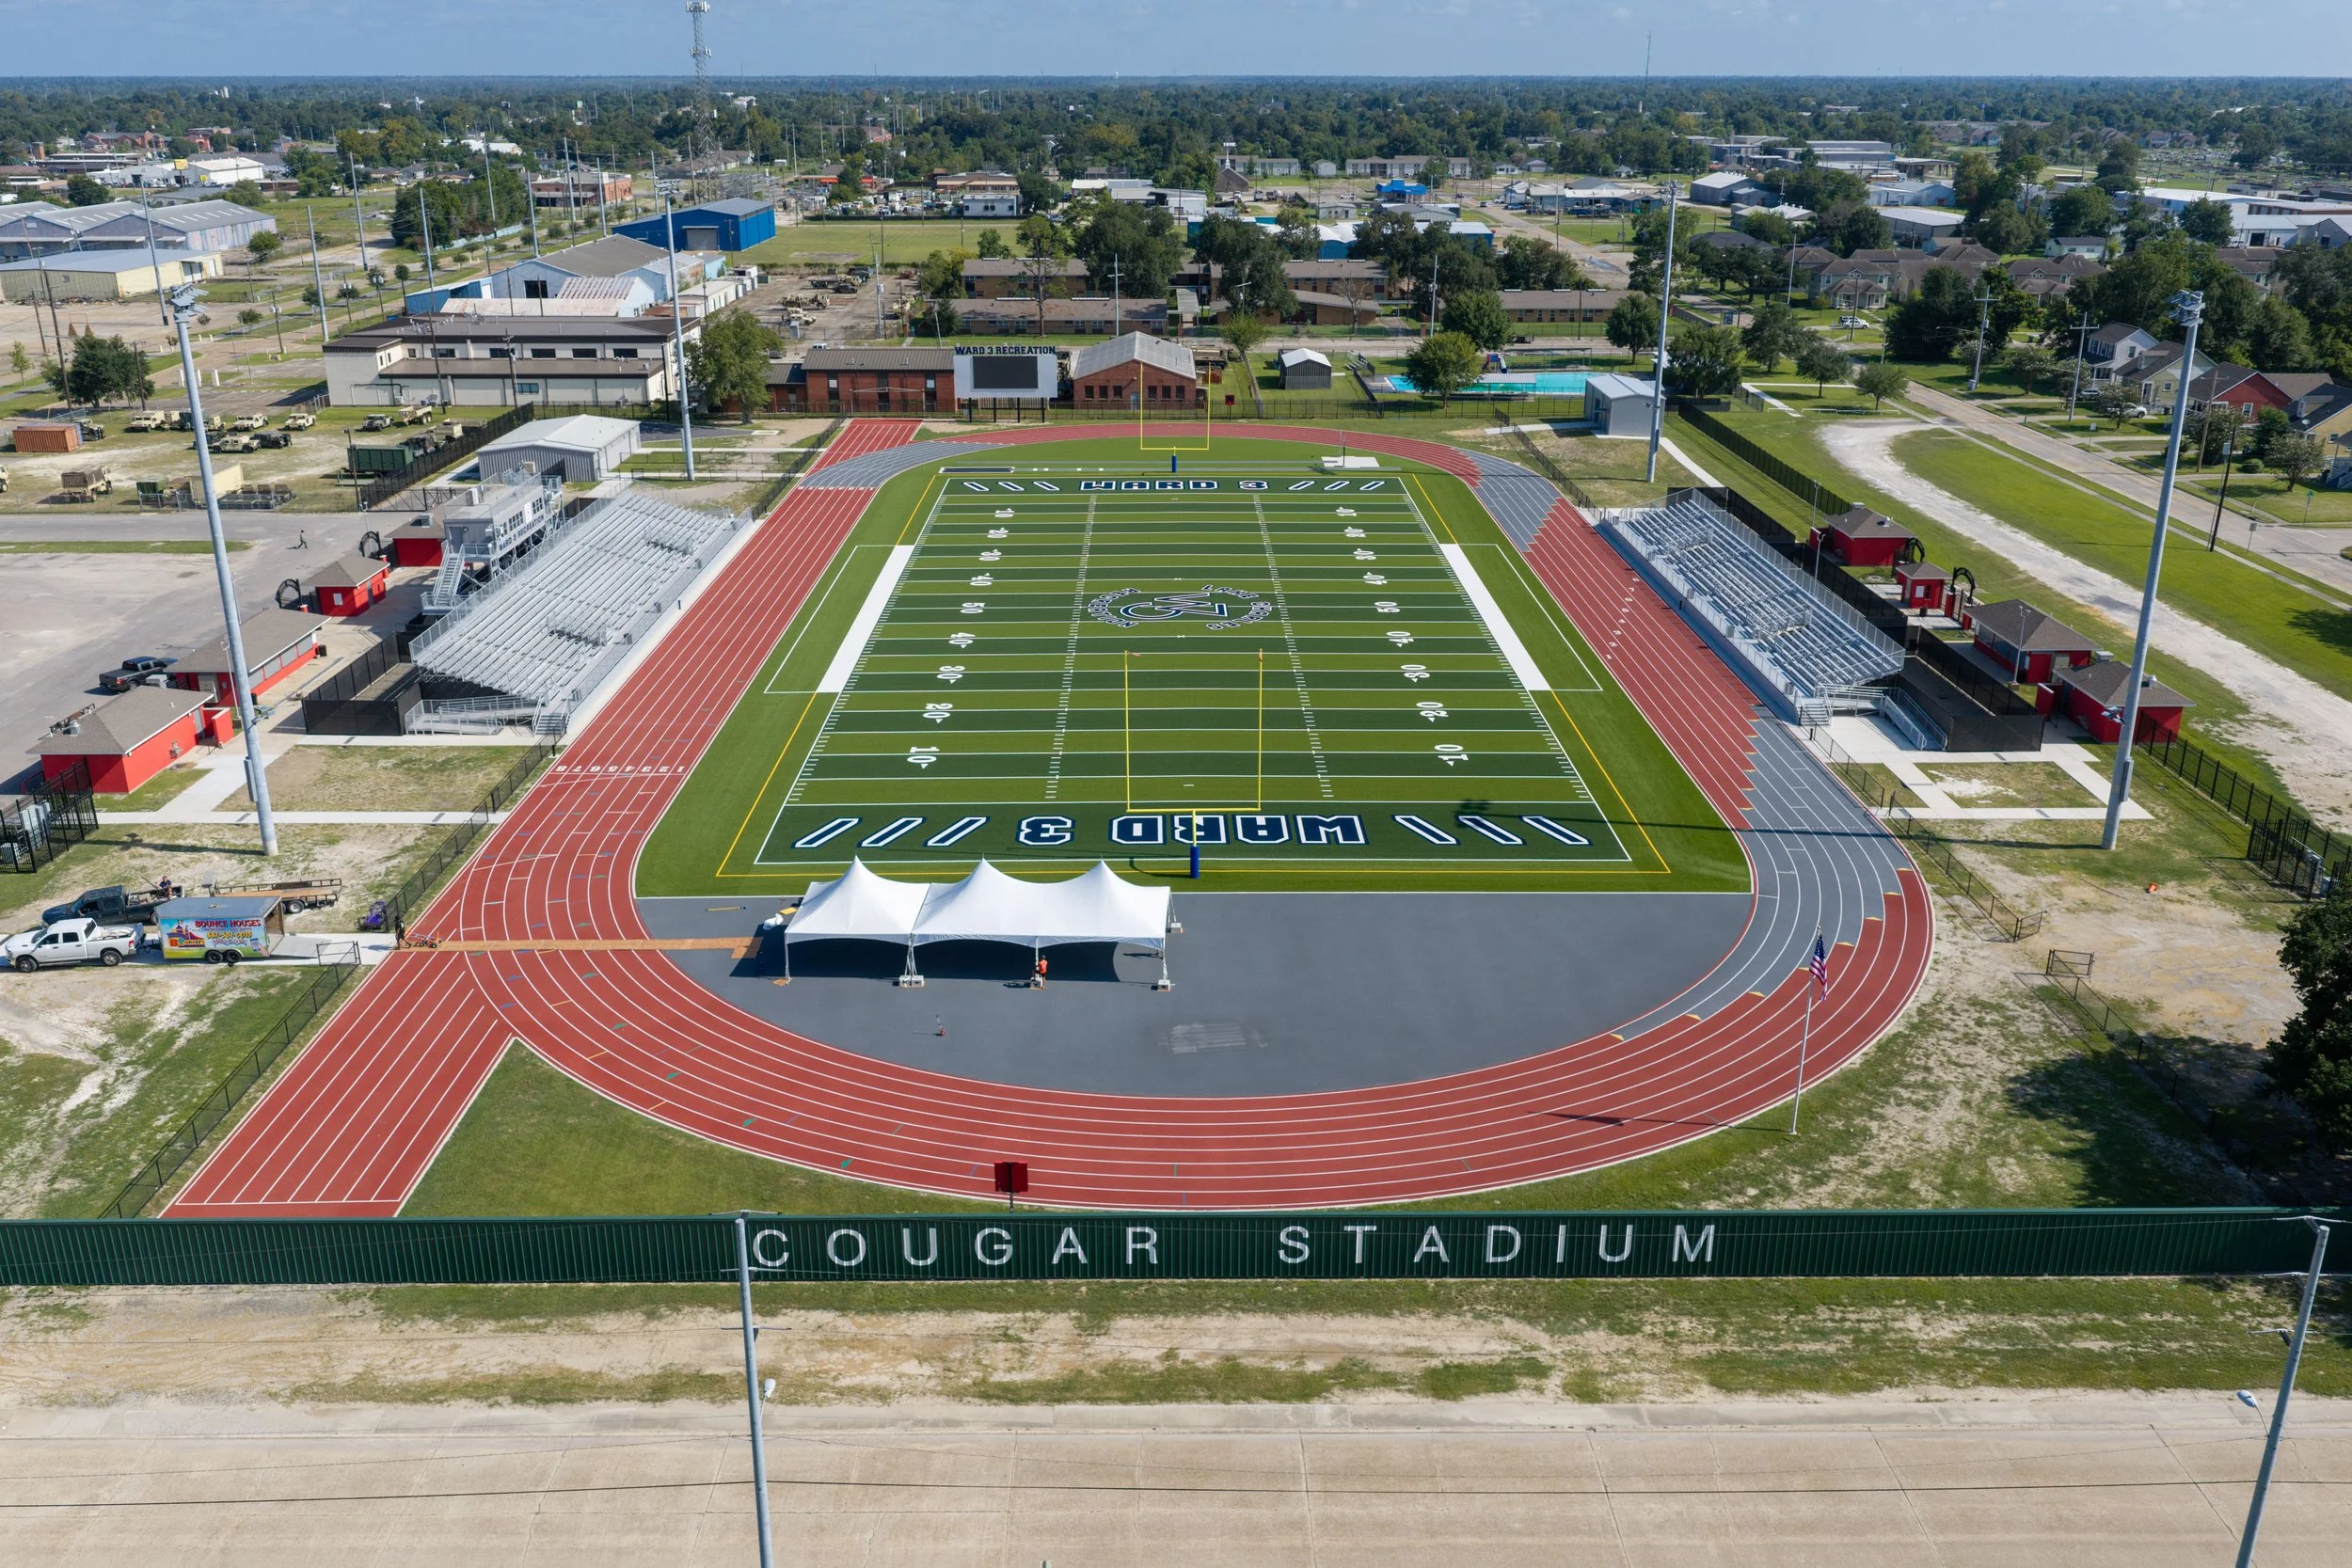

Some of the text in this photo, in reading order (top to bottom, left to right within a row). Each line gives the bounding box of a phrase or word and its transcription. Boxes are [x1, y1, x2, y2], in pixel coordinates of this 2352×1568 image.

[955, 346, 1056, 355] WARD 3 RECREATION
[1080, 481, 1269, 491] WARD 3
[970, 576, 993, 586] 40
[1363, 575, 1388, 585] 40
[1201, 584, 1259, 599] LAKE
[960, 602, 985, 613] 50
[1088, 588, 1142, 628] RECREATION
[1374, 601, 1400, 613] 50
[948, 632, 976, 645] 40
[1386, 631, 1414, 643] 40
[936, 666, 965, 679] 30
[1401, 664, 1430, 678] 30
[923, 703, 953, 719] 20
[1416, 702, 1449, 718] 20
[907, 746, 940, 764] 10
[1434, 744, 1469, 761] 10
[1016, 814, 1370, 846] WARD 3
[230, 919, 262, 927] HOUSES
[753, 1224, 1715, 1267] COUGAR STADIUM
